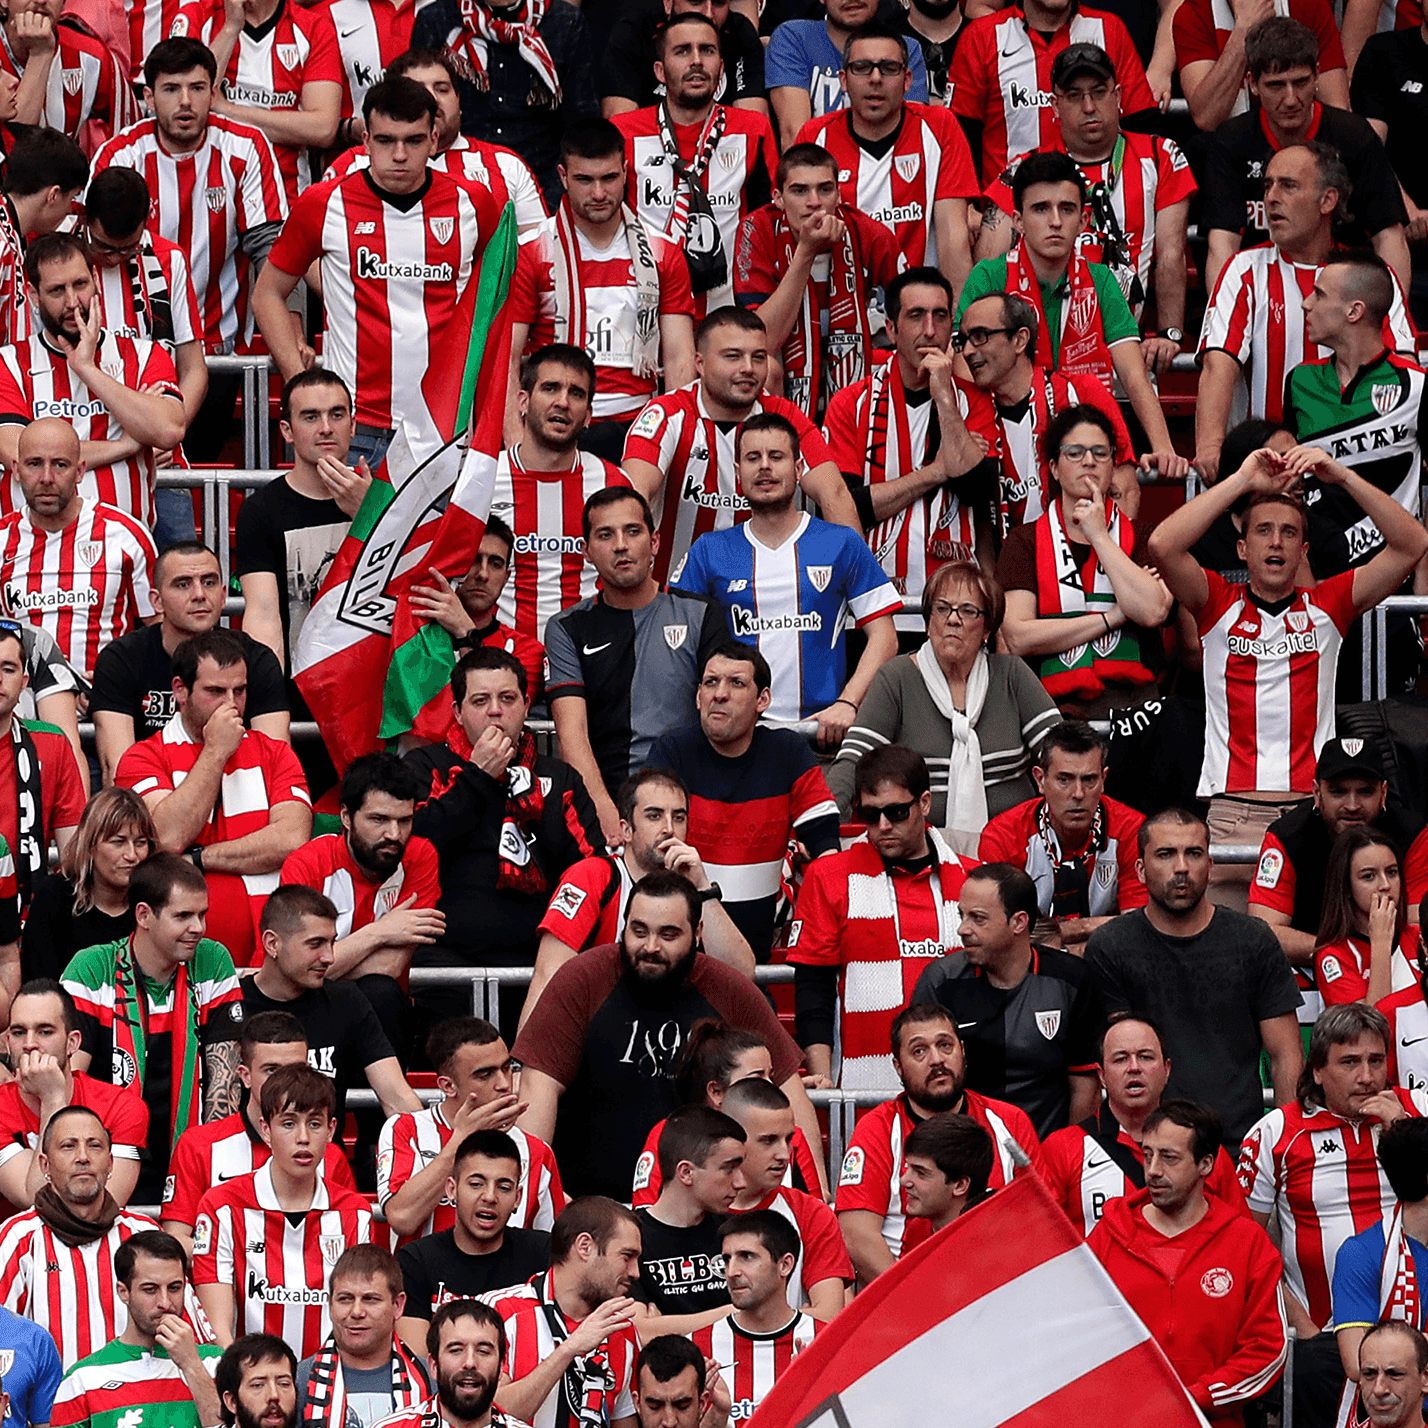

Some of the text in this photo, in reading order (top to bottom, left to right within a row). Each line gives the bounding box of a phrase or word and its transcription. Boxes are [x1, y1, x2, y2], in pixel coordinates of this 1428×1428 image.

[360, 249, 453, 280] Kutxabank
[6, 584, 98, 611] Kutxabank
[733, 605, 822, 637] Kutxabank
[1226, 631, 1320, 658] euskaltel
